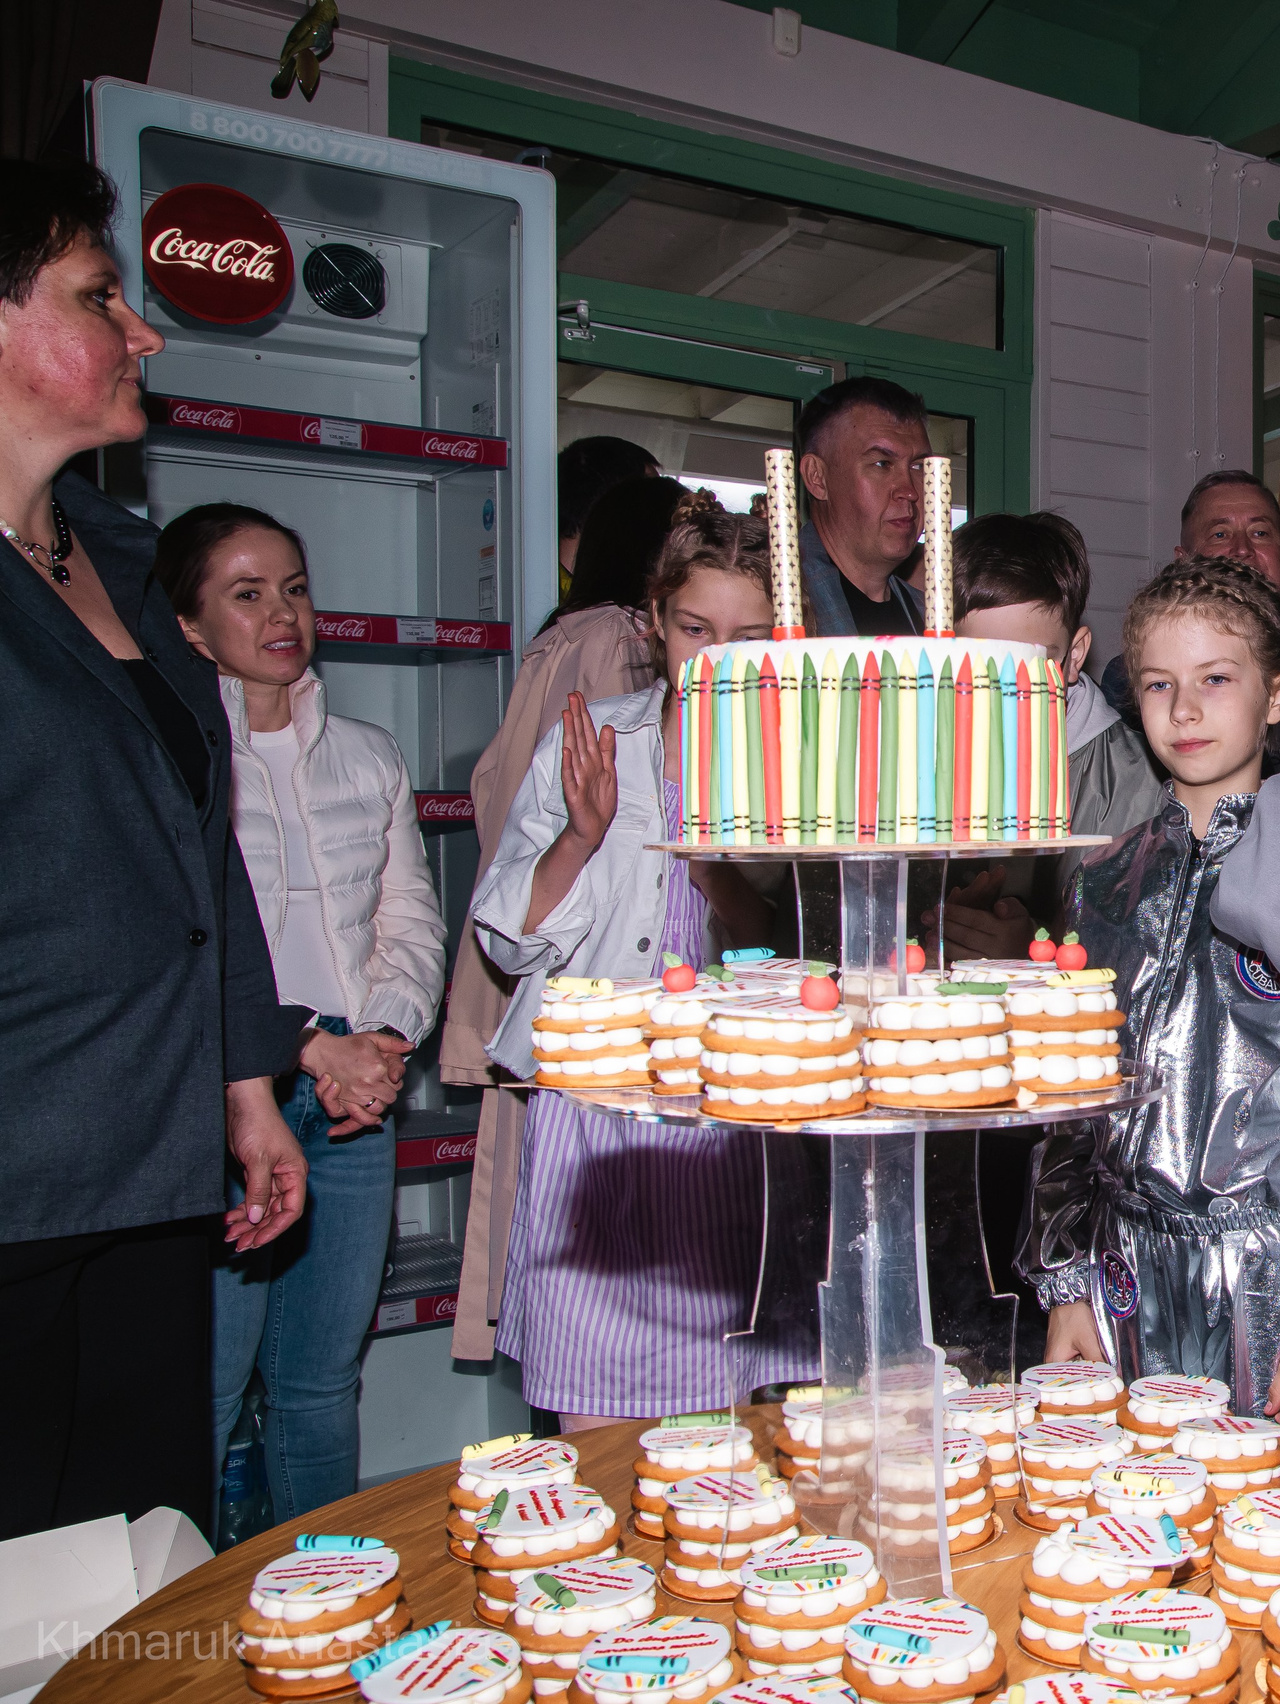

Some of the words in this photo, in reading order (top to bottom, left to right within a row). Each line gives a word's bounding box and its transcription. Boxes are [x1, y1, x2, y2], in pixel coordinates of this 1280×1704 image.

[190, 112, 207, 131] 8
[213, 116, 268, 144] 800
[273, 129, 324, 154] 700
[327, 139, 389, 167] 7777
[150, 227, 282, 282] Coca-Cola
[172, 404, 235, 429] Coca-Cola
[425, 437, 480, 459] Coca-Cola
[423, 798, 474, 816] Coca-Cola
[436, 1138, 478, 1159] Coca-Co
